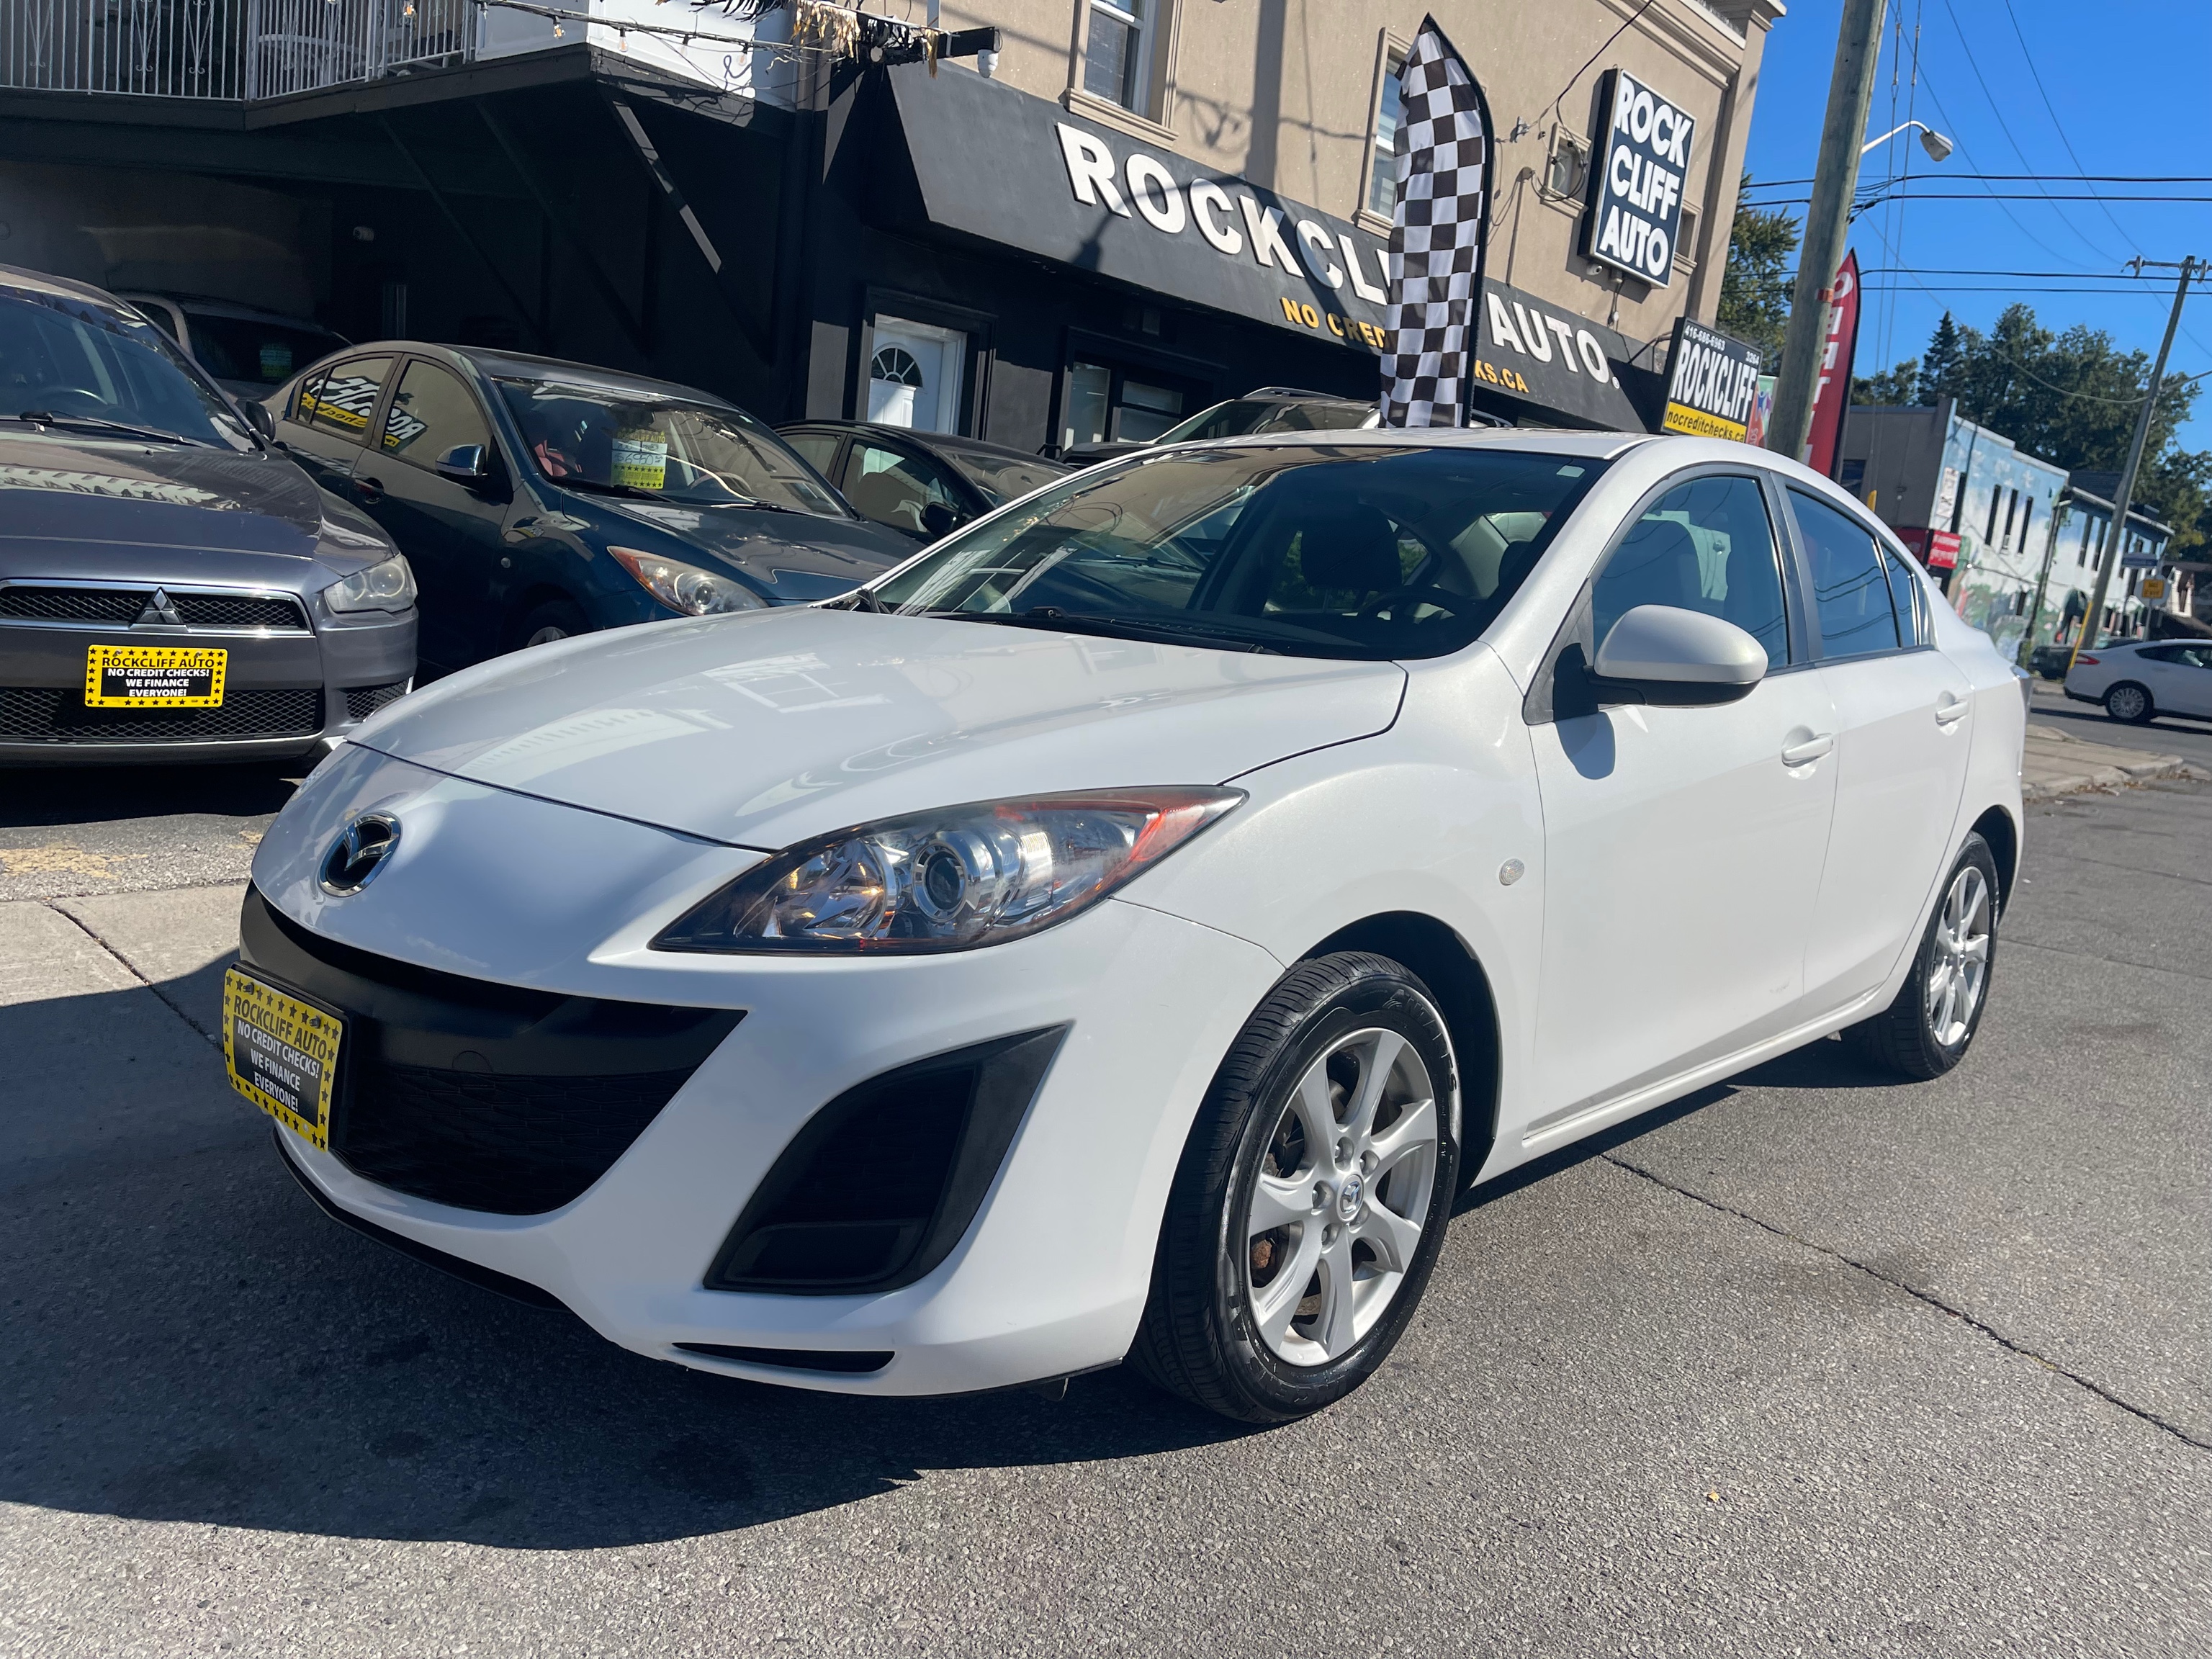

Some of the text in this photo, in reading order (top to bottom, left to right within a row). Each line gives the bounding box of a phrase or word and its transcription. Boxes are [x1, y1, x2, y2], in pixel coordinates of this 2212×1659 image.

[1615, 76, 1692, 168] ROCK
[1611, 145, 1681, 220] CLIFF
[1057, 122, 1390, 307] ROCKCL
[1599, 204, 1669, 276] AUTO
[1281, 297, 1529, 393] NO CRED KS.CA
[1671, 339, 1758, 422] ROCKCLIFF
[1667, 410, 1745, 443] nocreditchecks.ca
[102, 657, 215, 667] ROCKCLIFF AUTO
[108, 668, 210, 677] NO CREDIT CHECKS!
[129, 688, 187, 697] EVERYONE!
[234, 995, 328, 1060] ROCKCLIFF AUTO
[237, 1020, 320, 1079] NO CREDIT CHECKS!
[251, 1048, 301, 1092] WE FINANCE
[254, 1071, 299, 1112] EVERYONE!
